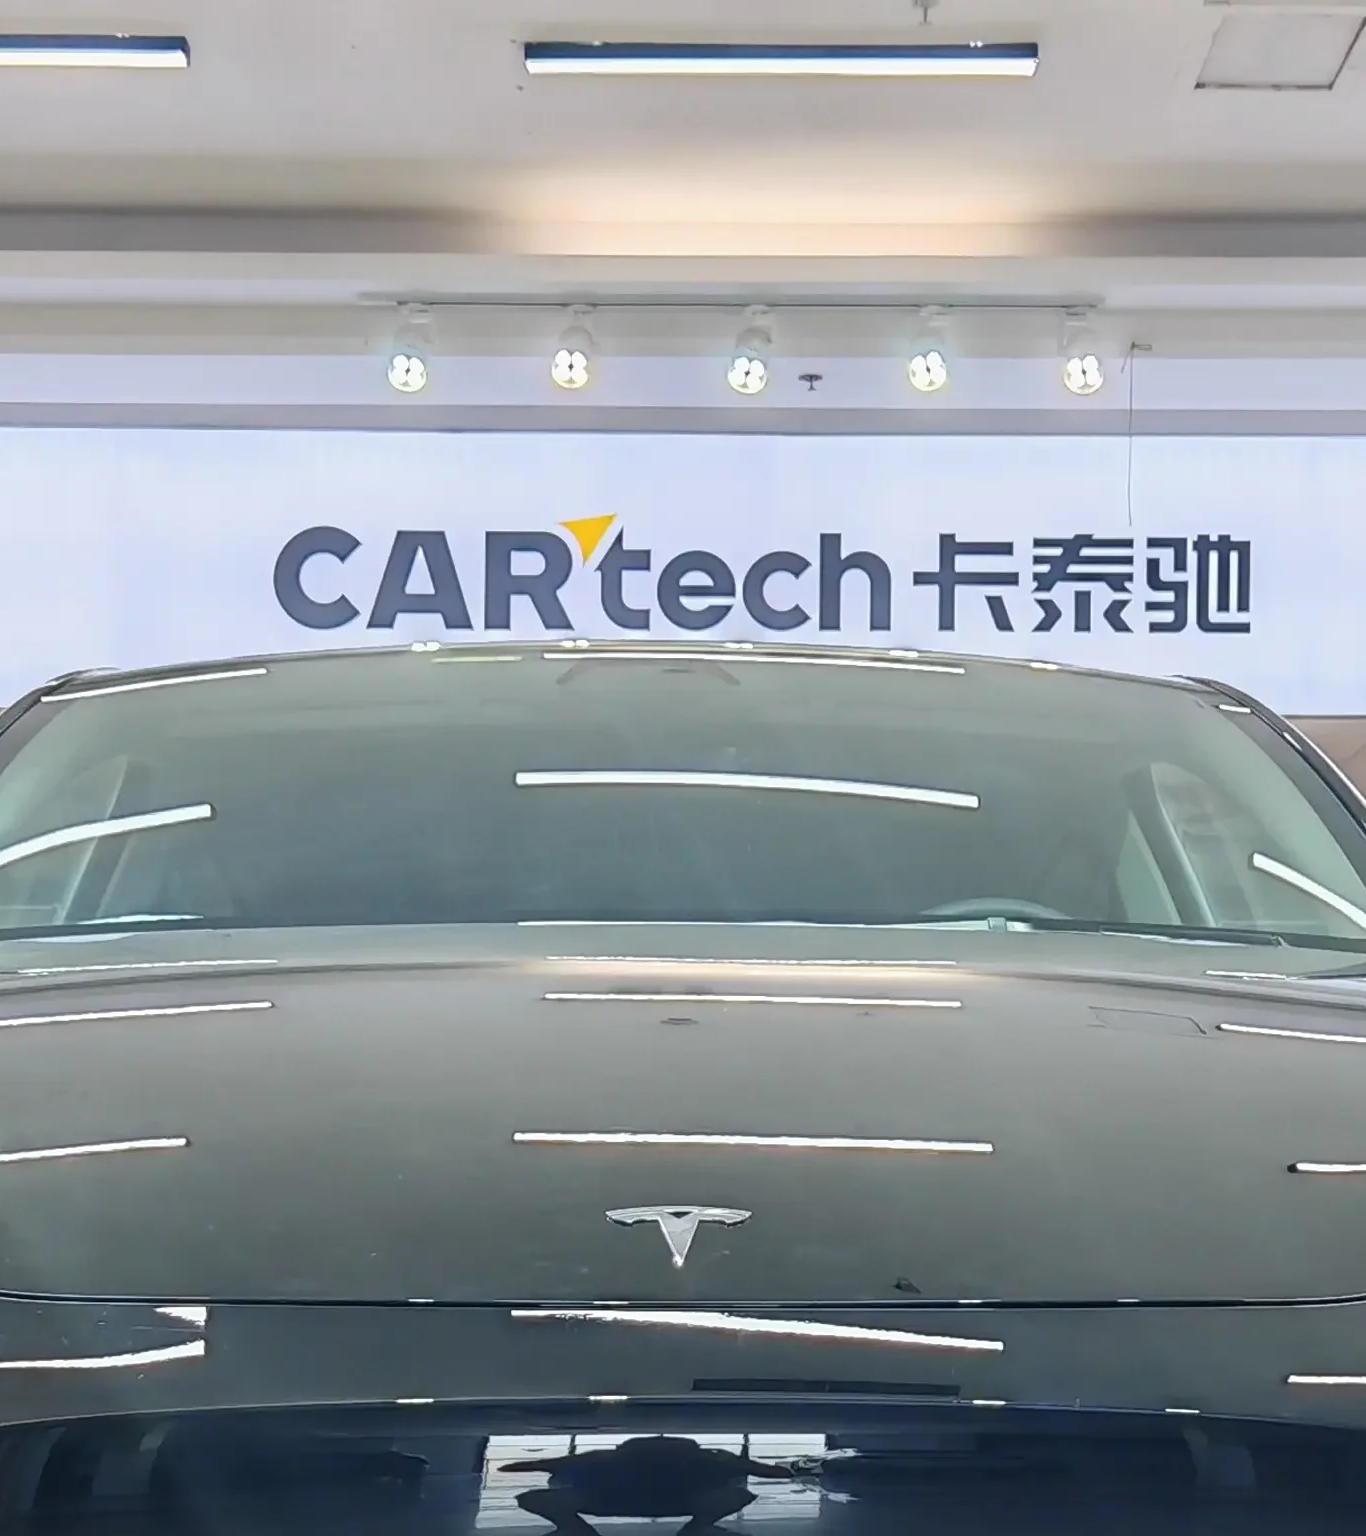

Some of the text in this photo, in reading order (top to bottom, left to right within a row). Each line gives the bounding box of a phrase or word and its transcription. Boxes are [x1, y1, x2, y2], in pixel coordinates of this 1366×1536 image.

[272, 523, 1252, 635] CARtech 卡泰驰
